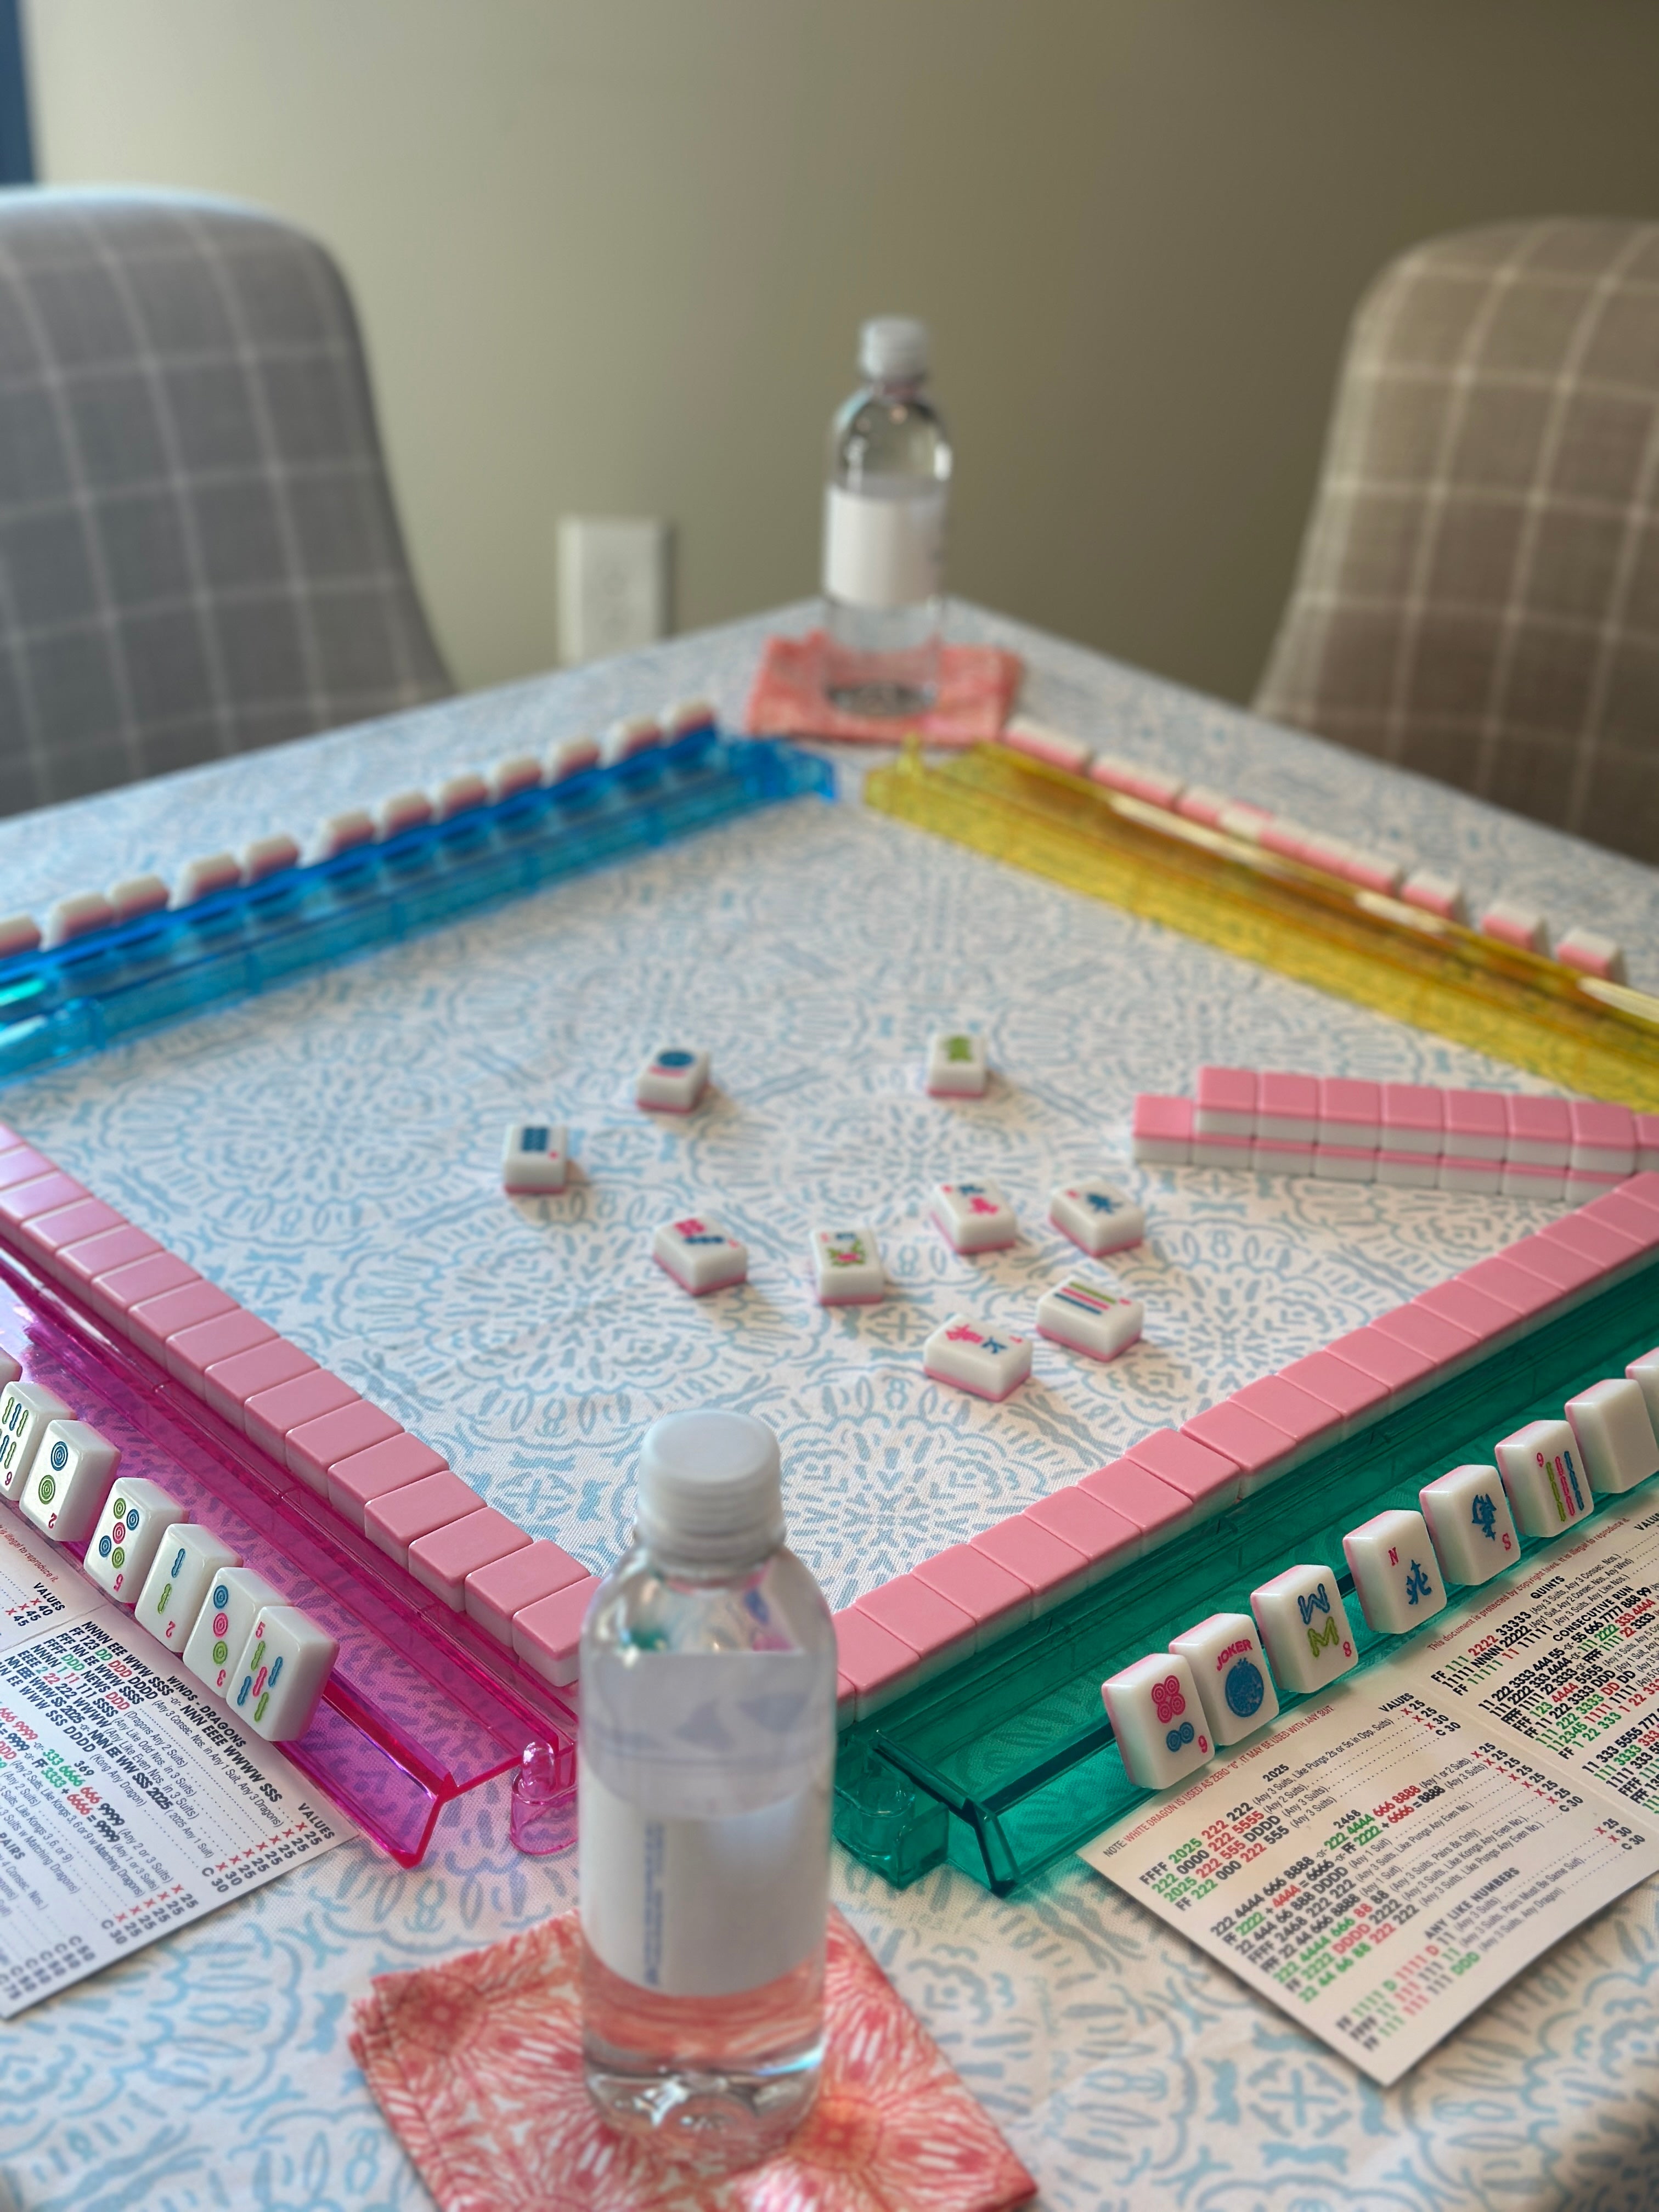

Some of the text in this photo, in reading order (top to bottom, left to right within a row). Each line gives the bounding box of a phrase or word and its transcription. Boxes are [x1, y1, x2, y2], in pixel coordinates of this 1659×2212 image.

[1389, 1547, 1399, 1566] N
[1502, 1532, 1511, 1551] S
[33, 1582, 65, 1610] VALUES
[1530, 1576, 1565, 1599] QUINTS
[26, 1611, 42, 1621] 45
[38, 1605, 53, 1616] 40
[1553, 1585, 1634, 1641] CONSECUTIVE RUN
[256, 1621, 266, 1638] 5
[1430, 1670, 1446, 1682] FF
[1444, 1655, 1469, 1671] 111
[1468, 1635, 1499, 1656] 2222
[1495, 1611, 1532, 1635] 33333
[1564, 1581, 1579, 1590] Any
[1217, 1639, 1253, 1671] JOKER
[1343, 1641, 1352, 1657] 8
[1478, 1699, 1495, 1710] 11
[1491, 1685, 1514, 1702] 222
[1508, 1669, 1536, 1688] 3333
[1532, 1656, 1553, 1671] 444
[1547, 1647, 1565, 1659] 55
[1570, 1631, 1587, 1643] 55
[1583, 1620, 1604, 1634] 666
[1598, 1605, 1624, 1623] 7777
[1620, 1594, 1641, 1608] 888
[1635, 1587, 1652, 1597] 99
[166, 1675, 198, 1701] WINDS
[199, 1705, 246, 1747] DRAGONS
[1378, 1692, 1414, 1712] VALUES
[81, 1621, 113, 1644] NNNN
[106, 1642, 128, 1656] EEE
[122, 1654, 154, 1677] WWW
[147, 1676, 174, 1696] SSSS
[179, 1704, 207, 1726] NNN
[201, 1725, 228, 1746] EEEE
[223, 1745, 265, 1782] WWWW
[259, 1783, 282, 1802] SSS
[303, 1831, 323, 1845] 25
[43, 1638, 67, 1654] FFFF
[60, 1653, 84, 1671] DDD
[80, 1669, 111, 1692] NEWS
[105, 1691, 130, 1709] DDD
[149, 1734, 165, 1745] Any
[264, 1850, 283, 1865] 25
[74, 1760, 94, 1776] 369
[1123, 1823, 1149, 1842] WHITE
[1146, 1803, 1178, 1826] DRAGON
[1173, 1798, 1185, 1806] IS
[1181, 1786, 1203, 1801] USED
[1200, 1779, 1214, 1789] AS
[1209, 1768, 1230, 1782] ZERO
[1244, 1745, 1263, 1758] MAY
[1259, 1740, 1274, 1749] BE
[1267, 1730, 1290, 1744] USED
[1285, 1720, 1307, 1733] WITH
[1304, 1711, 1319, 1724] ANY
[1313, 1704, 1335, 1717] SUIT
[1262, 1764, 1289, 1782] 2025
[1139, 1861, 1167, 1884] FFFF
[1168, 1838, 1202, 1864] 2025
[1201, 1820, 1229, 1839] 222
[1226, 1802, 1254, 1821] 222
[1291, 1768, 1309, 1778] Like
[1305, 1755, 1329, 1770] Pungs
[1408, 1700, 1425, 1710] 25
[297, 1802, 335, 1839] VALUES
[1175, 1897, 1191, 1911] FF
[1190, 1878, 1218, 1899] 222
[1215, 1860, 1242, 1880] 000
[1240, 1842, 1267, 1863] 222
[1262, 1825, 1289, 1844] 555
[1444, 1722, 1461, 1731] 30
[1333, 1809, 1361, 1829] 2468
[1210, 1916, 1237, 1936] 222
[1235, 1893, 1265, 1918] 4444
[1262, 1877, 1286, 1896] 666
[1283, 1856, 1314, 1879] 8888
[1323, 1832, 1349, 1850] 222
[1346, 1813, 1375, 1835] 4444
[1372, 1801, 1395, 1816] 666
[1391, 1785, 1421, 1803] 8888
[1479, 1742, 1496, 1753] 25
[1425, 1867, 1520, 1939] ANY LIKE NUMBERS
